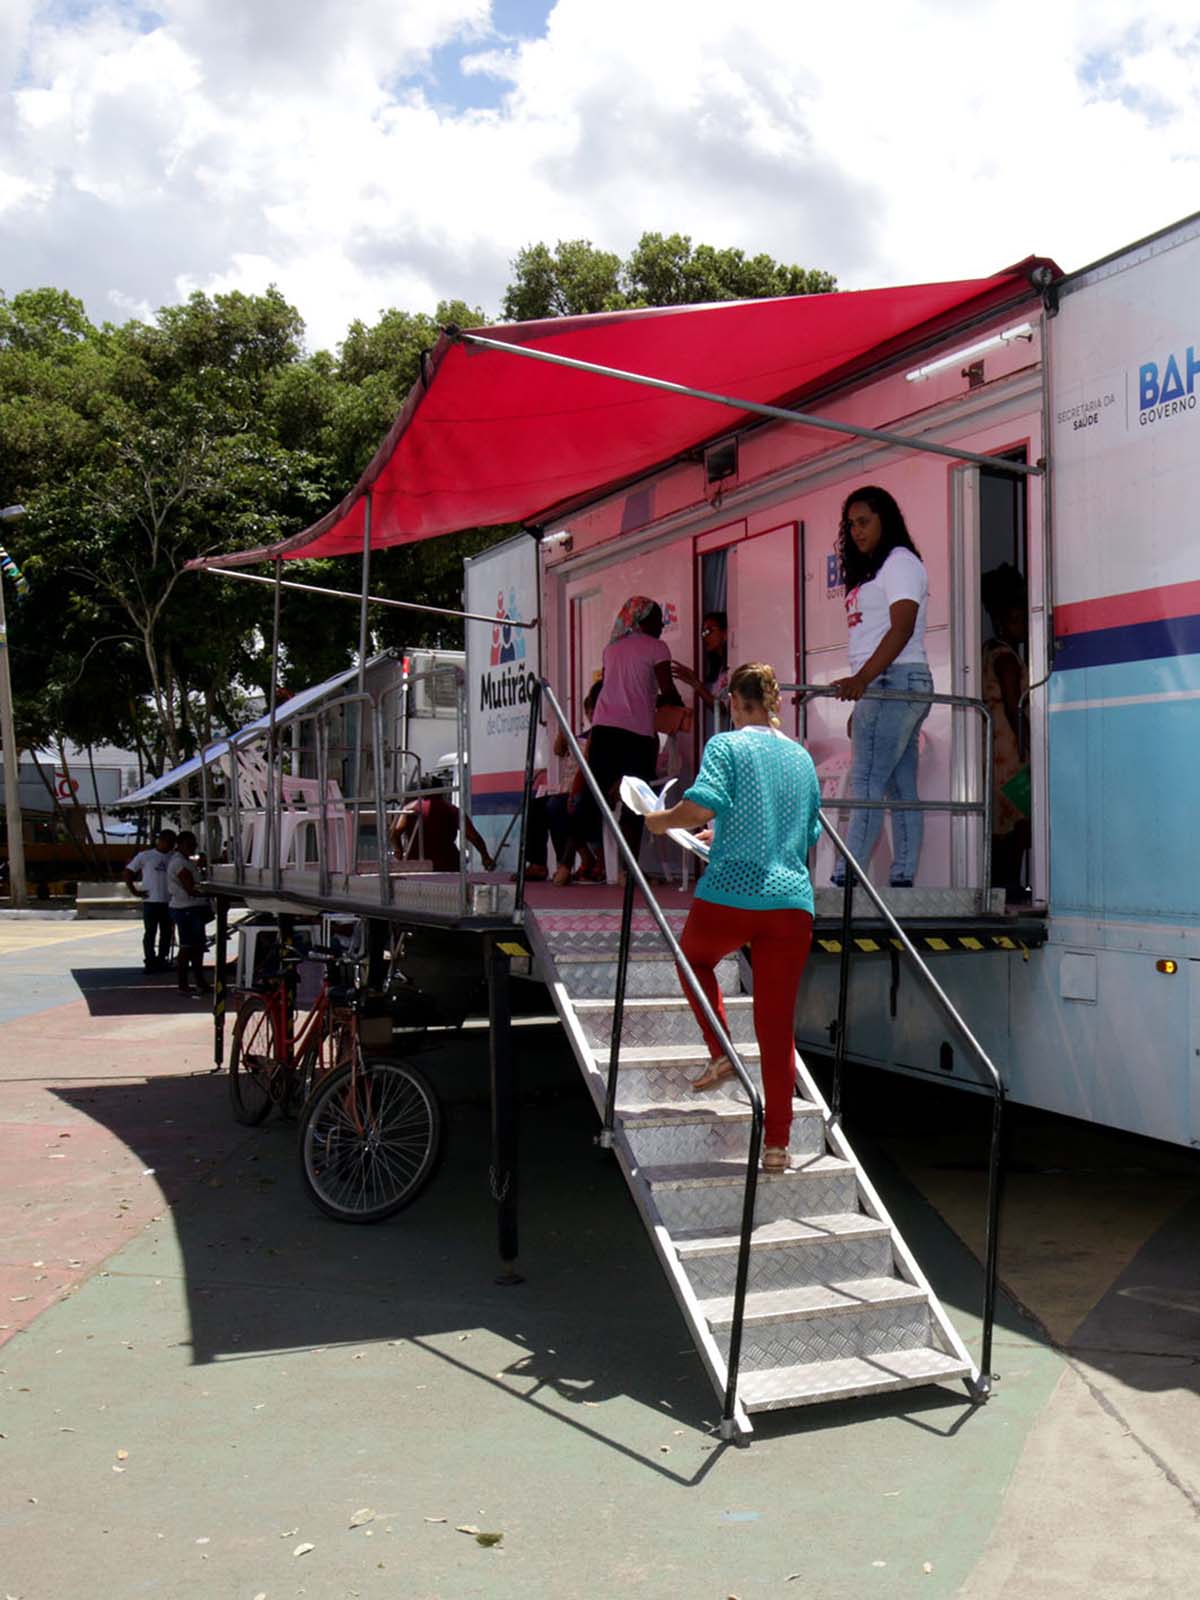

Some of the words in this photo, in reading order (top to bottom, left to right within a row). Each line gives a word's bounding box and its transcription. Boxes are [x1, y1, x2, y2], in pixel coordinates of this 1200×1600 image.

[1057, 399, 1102, 424] SECRETARIA
[1103, 392, 1116, 408] DA
[1072, 412, 1099, 431] SAÚDE
[1139, 394, 1197, 427] GOVERNO
[480, 661, 536, 712] Mutirão
